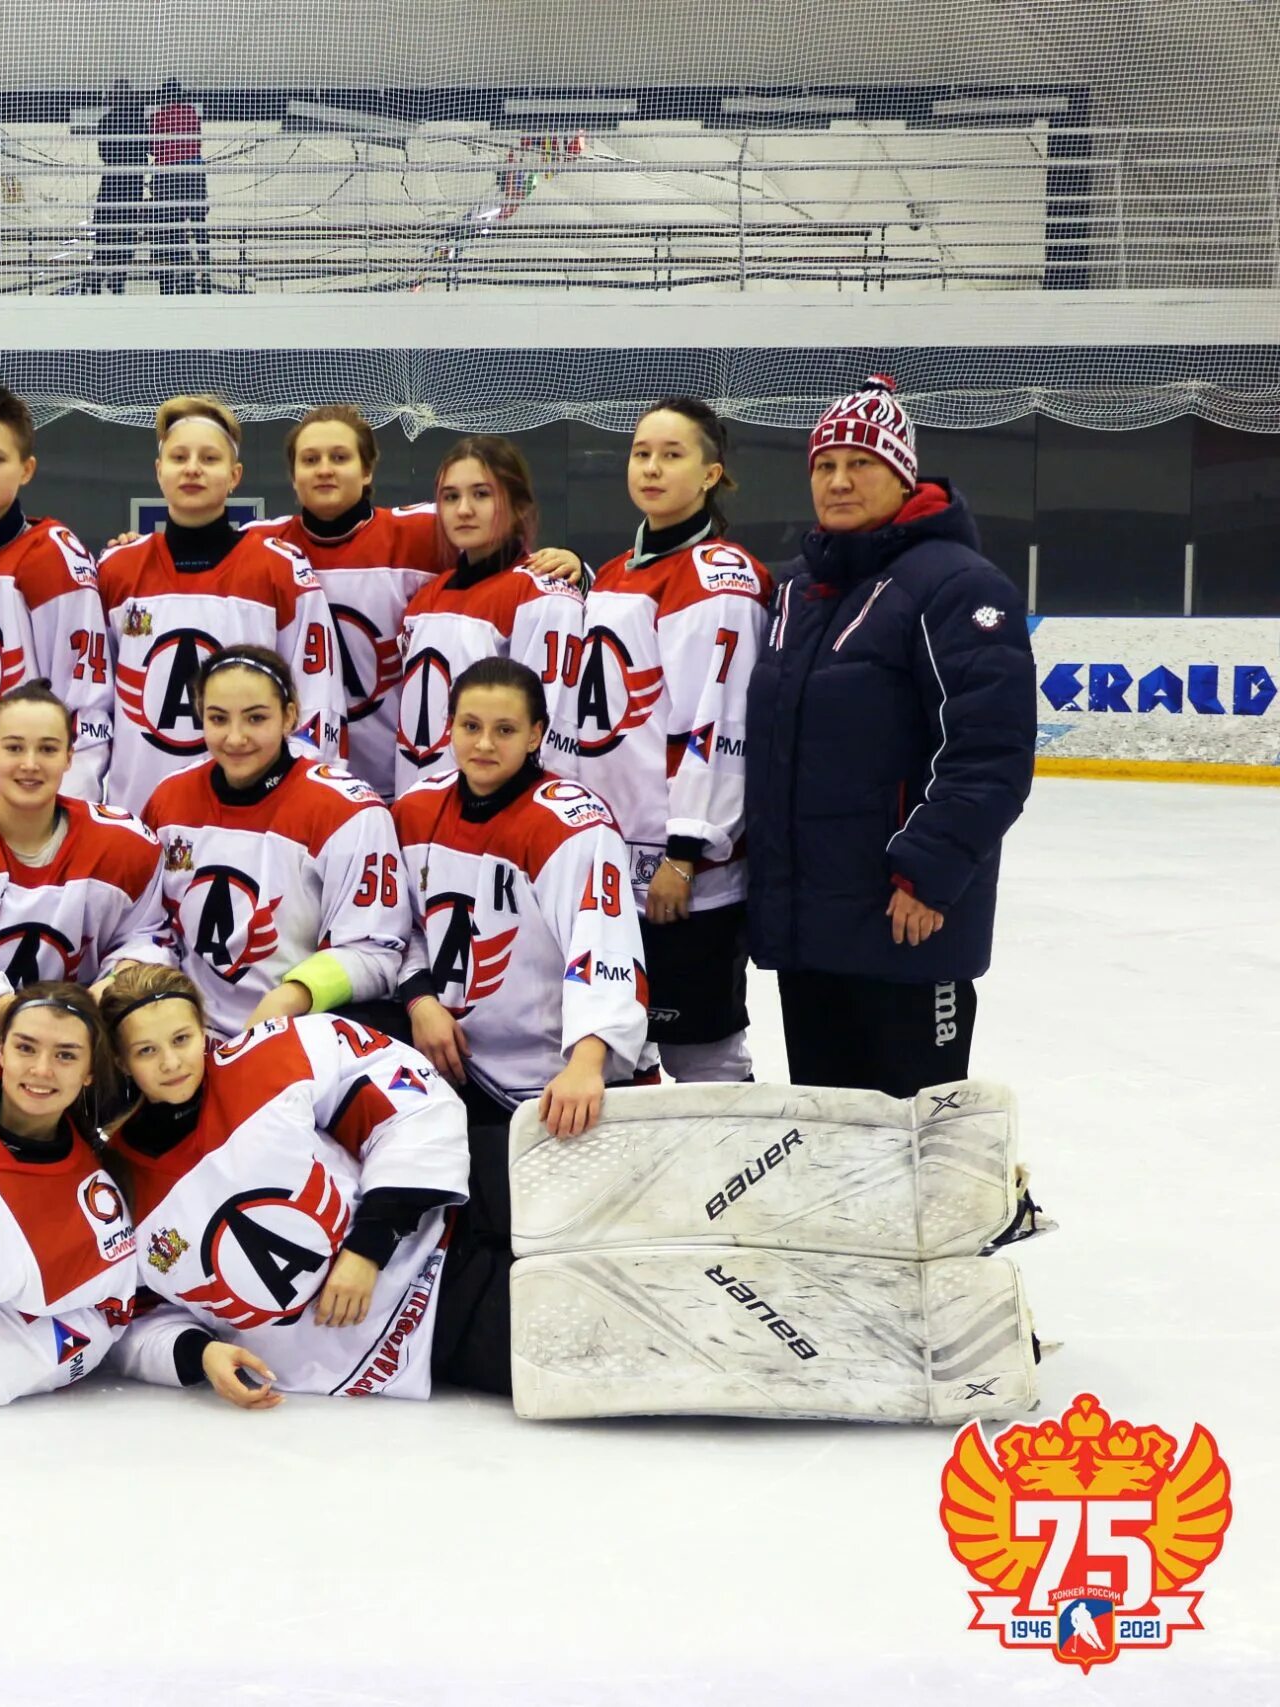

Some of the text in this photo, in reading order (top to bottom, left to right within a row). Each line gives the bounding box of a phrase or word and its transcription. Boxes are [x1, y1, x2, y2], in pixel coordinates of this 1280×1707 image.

[70, 629, 108, 684] 24
[541, 630, 584, 688] 10
[716, 627, 739, 684] 7
[81, 722, 112, 739] РМК
[353, 852, 398, 908] 56
[493, 863, 519, 915] К
[594, 960, 632, 983] РМК
